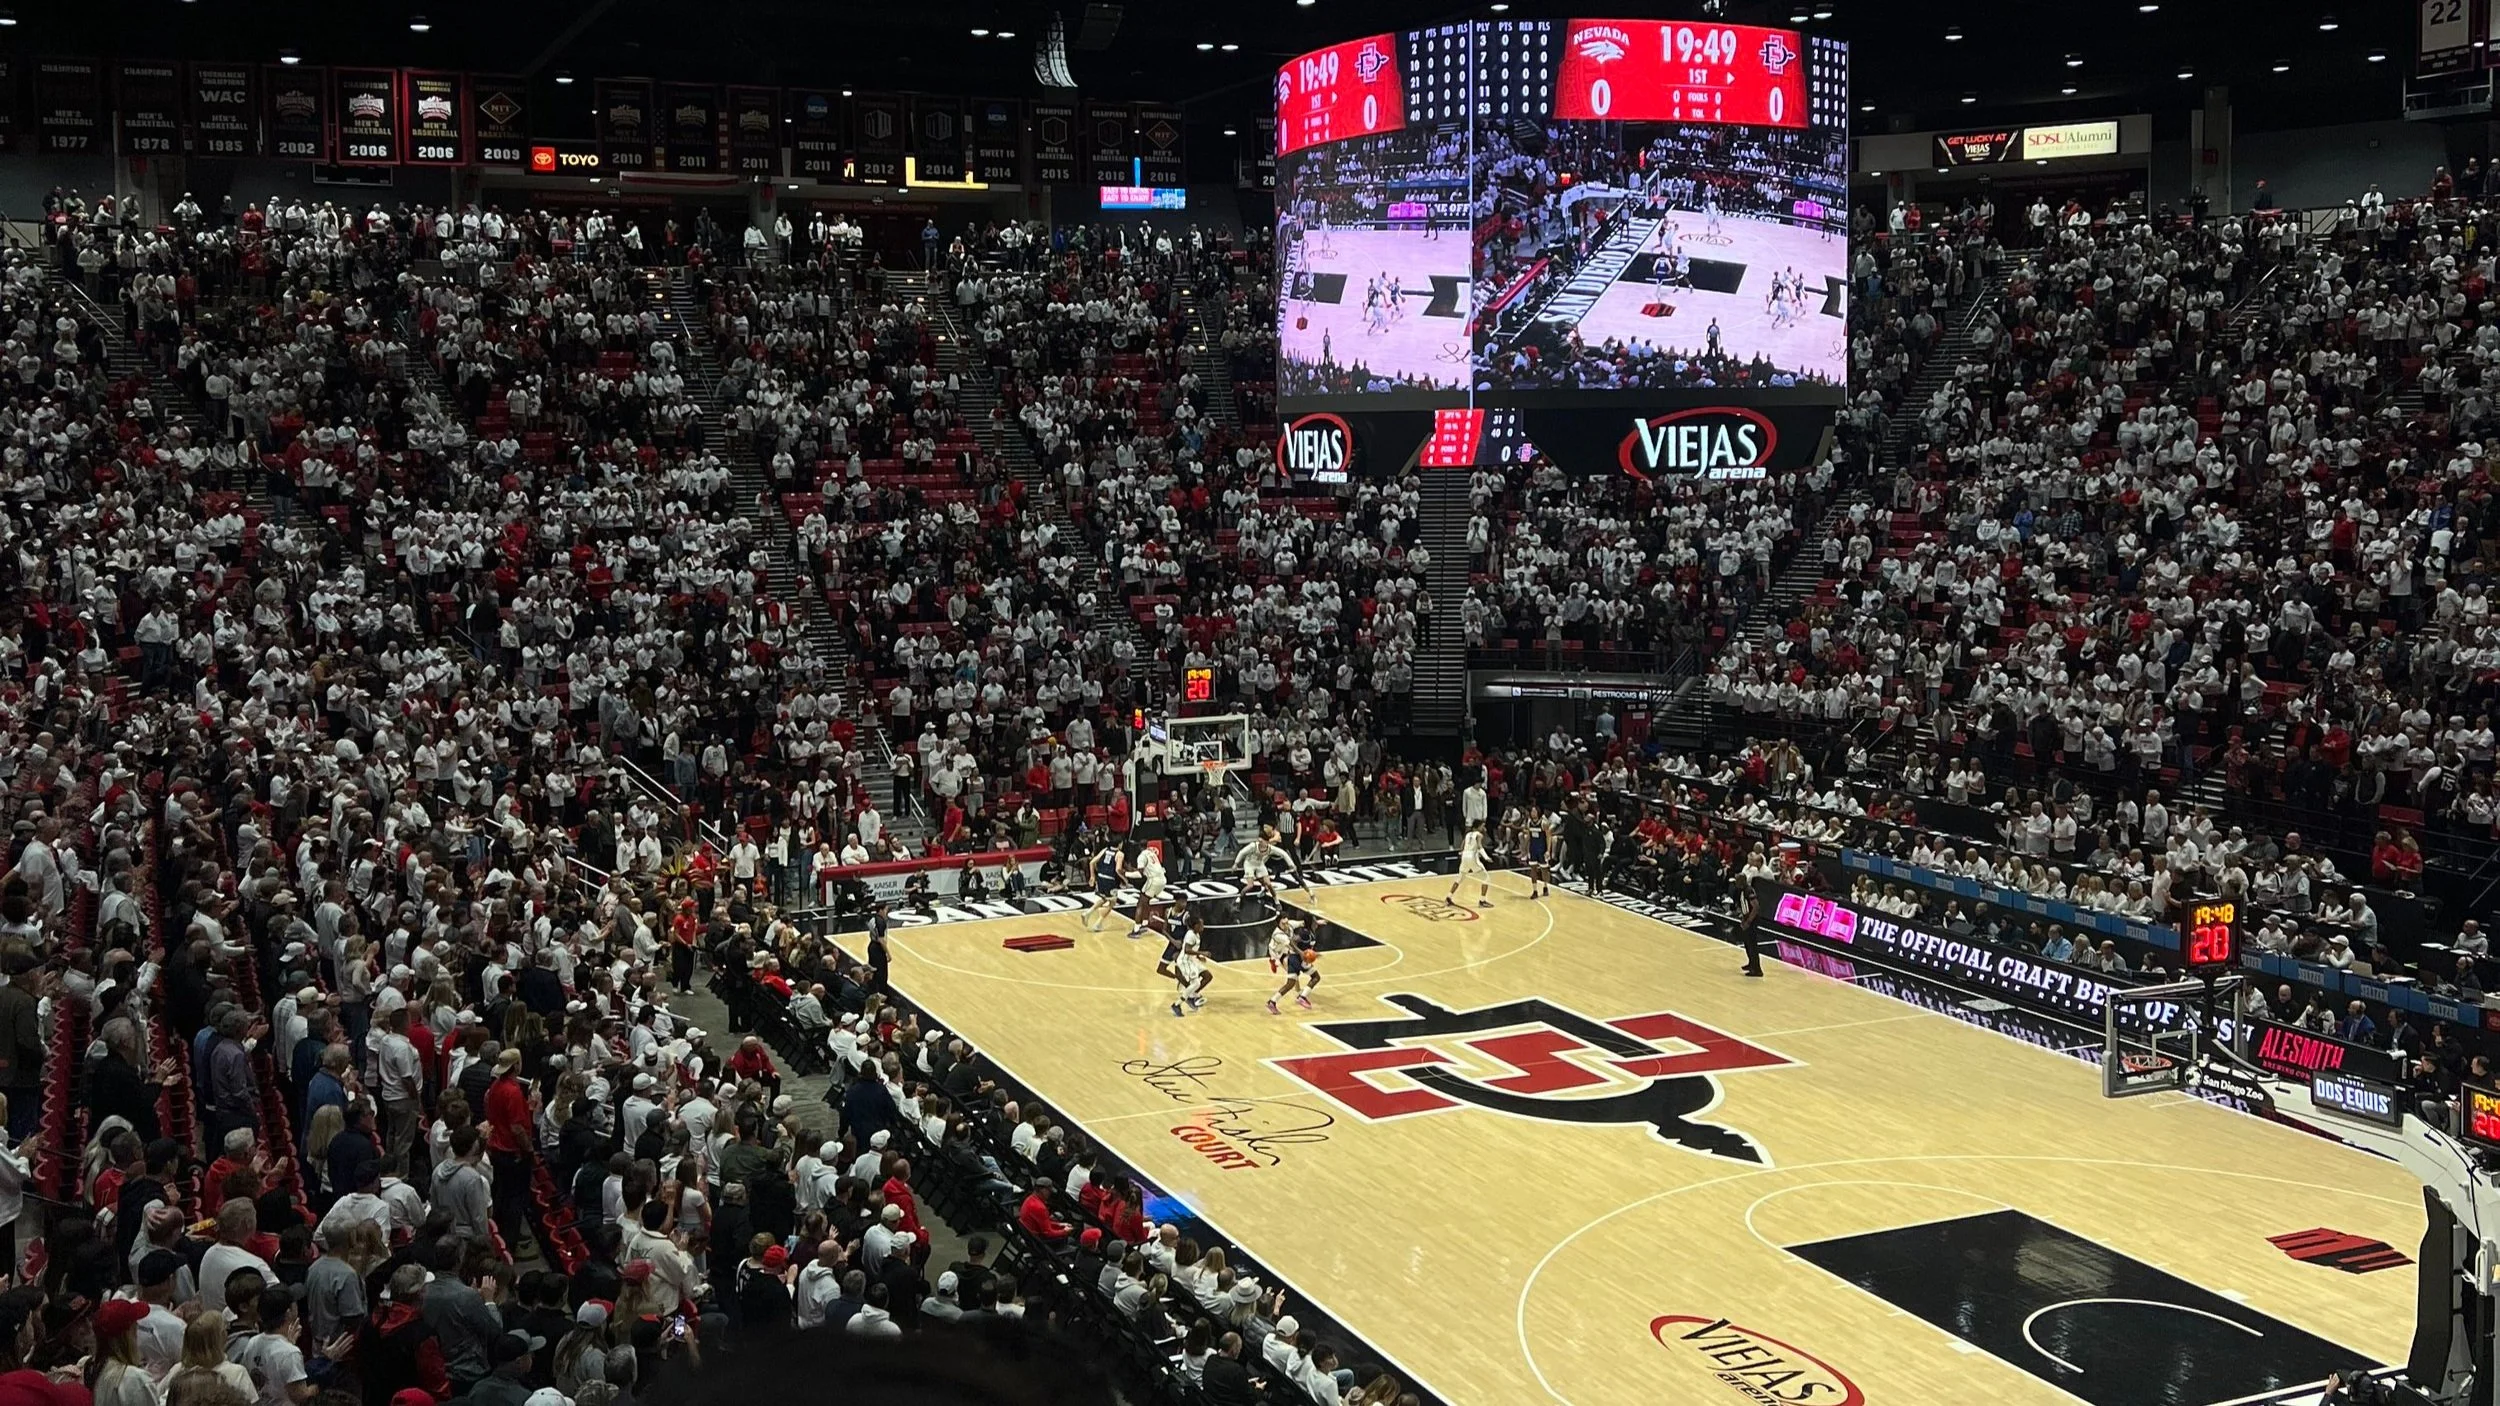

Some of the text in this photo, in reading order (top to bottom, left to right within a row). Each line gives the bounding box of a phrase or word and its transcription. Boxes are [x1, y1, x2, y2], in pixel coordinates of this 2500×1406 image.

[2431, 0, 2460, 25] 22
[1426, 28, 1436, 38] PTS
[1457, 23, 1467, 34] FLS
[1477, 21, 1550, 32] PLY PTS REB FLS
[1480, 34, 1547, 46] 3 0 0 0
[1573, 27, 1630, 45] NEVADA
[1661, 26, 1737, 65] 19:49
[1480, 51, 1547, 63] 7 0 0 0
[1300, 51, 1339, 94] 19:49
[1502, 68, 1509, 80] 0
[1522, 68, 1530, 80] 0
[1540, 68, 1547, 80] 0
[1689, 69, 1708, 84] 1ST
[199, 90, 246, 104] WAC
[1479, 85, 1547, 97] 11 0 0 0
[1591, 79, 1611, 116] 0
[1673, 90, 1680, 103] 0
[1715, 92, 1721, 104] 0
[1478, 102, 1547, 114] 53 0 0 0
[1769, 87, 1784, 122] 0
[1363, 94, 1377, 130] 0
[1673, 109, 1680, 120] 4
[51, 135, 88, 149] 1977
[133, 137, 171, 150] 1978
[207, 140, 244, 152] 1985
[1948, 133, 2008, 145] GET LUCKY AT
[279, 142, 315, 154] 2002
[349, 144, 387, 157] 2006
[418, 146, 454, 159] 2006
[484, 148, 520, 160] 2009
[560, 154, 600, 167] TOYO
[612, 153, 642, 165] 2010
[679, 155, 707, 168] 2011
[742, 158, 769, 169] 2011
[805, 160, 831, 171] 2011
[864, 163, 895, 175] 2012
[926, 164, 954, 176] 2014
[984, 167, 1012, 178] 2014
[1042, 168, 1070, 179] 2015
[1098, 170, 1125, 182] 2016
[1150, 172, 1177, 183] 2016
[1283, 422, 1343, 480] VIEJAS
[1501, 445, 1511, 462] 0
[1634, 418, 1758, 479] VIEJAS
[1709, 467, 1766, 479] arena
[1187, 680, 1209, 698] 20
[1593, 691, 1637, 699] RESTROOMS
[2441, 776, 2456, 791] 15
[874, 889, 905, 897] PERMAN
[888, 900, 1025, 928] SAN
[2196, 903, 2234, 925] 19:48
[2192, 925, 2230, 963] 20
[1861, 916, 1899, 944] THE
[1900, 928, 1993, 973] OFFICIAL
[1998, 957, 2073, 996] CRAFT
[2145, 1001, 2180, 1024] OF
[1888, 947, 2022, 992] PLEASE DRINK
[2298, 969, 2325, 984] SELTZER
[2360, 984, 2388, 1001] SELTZER
[2428, 1002, 2458, 1020] SELTZER
[2258, 1028, 2345, 1071] ALESMITH
[2262, 1060, 2294, 1076] BREWING
[2203, 1074, 2264, 1101] San Diego Zoo
[2315, 1078, 2391, 1114] DOS EQUIS
[2474, 1092, 2500, 1116] 19:4
[2475, 1112, 2500, 1140] 20
[1170, 1125, 1261, 1170] COURT
[1680, 1318, 1837, 1401] VIEJAS
[1717, 1372, 1780, 1406] aren
